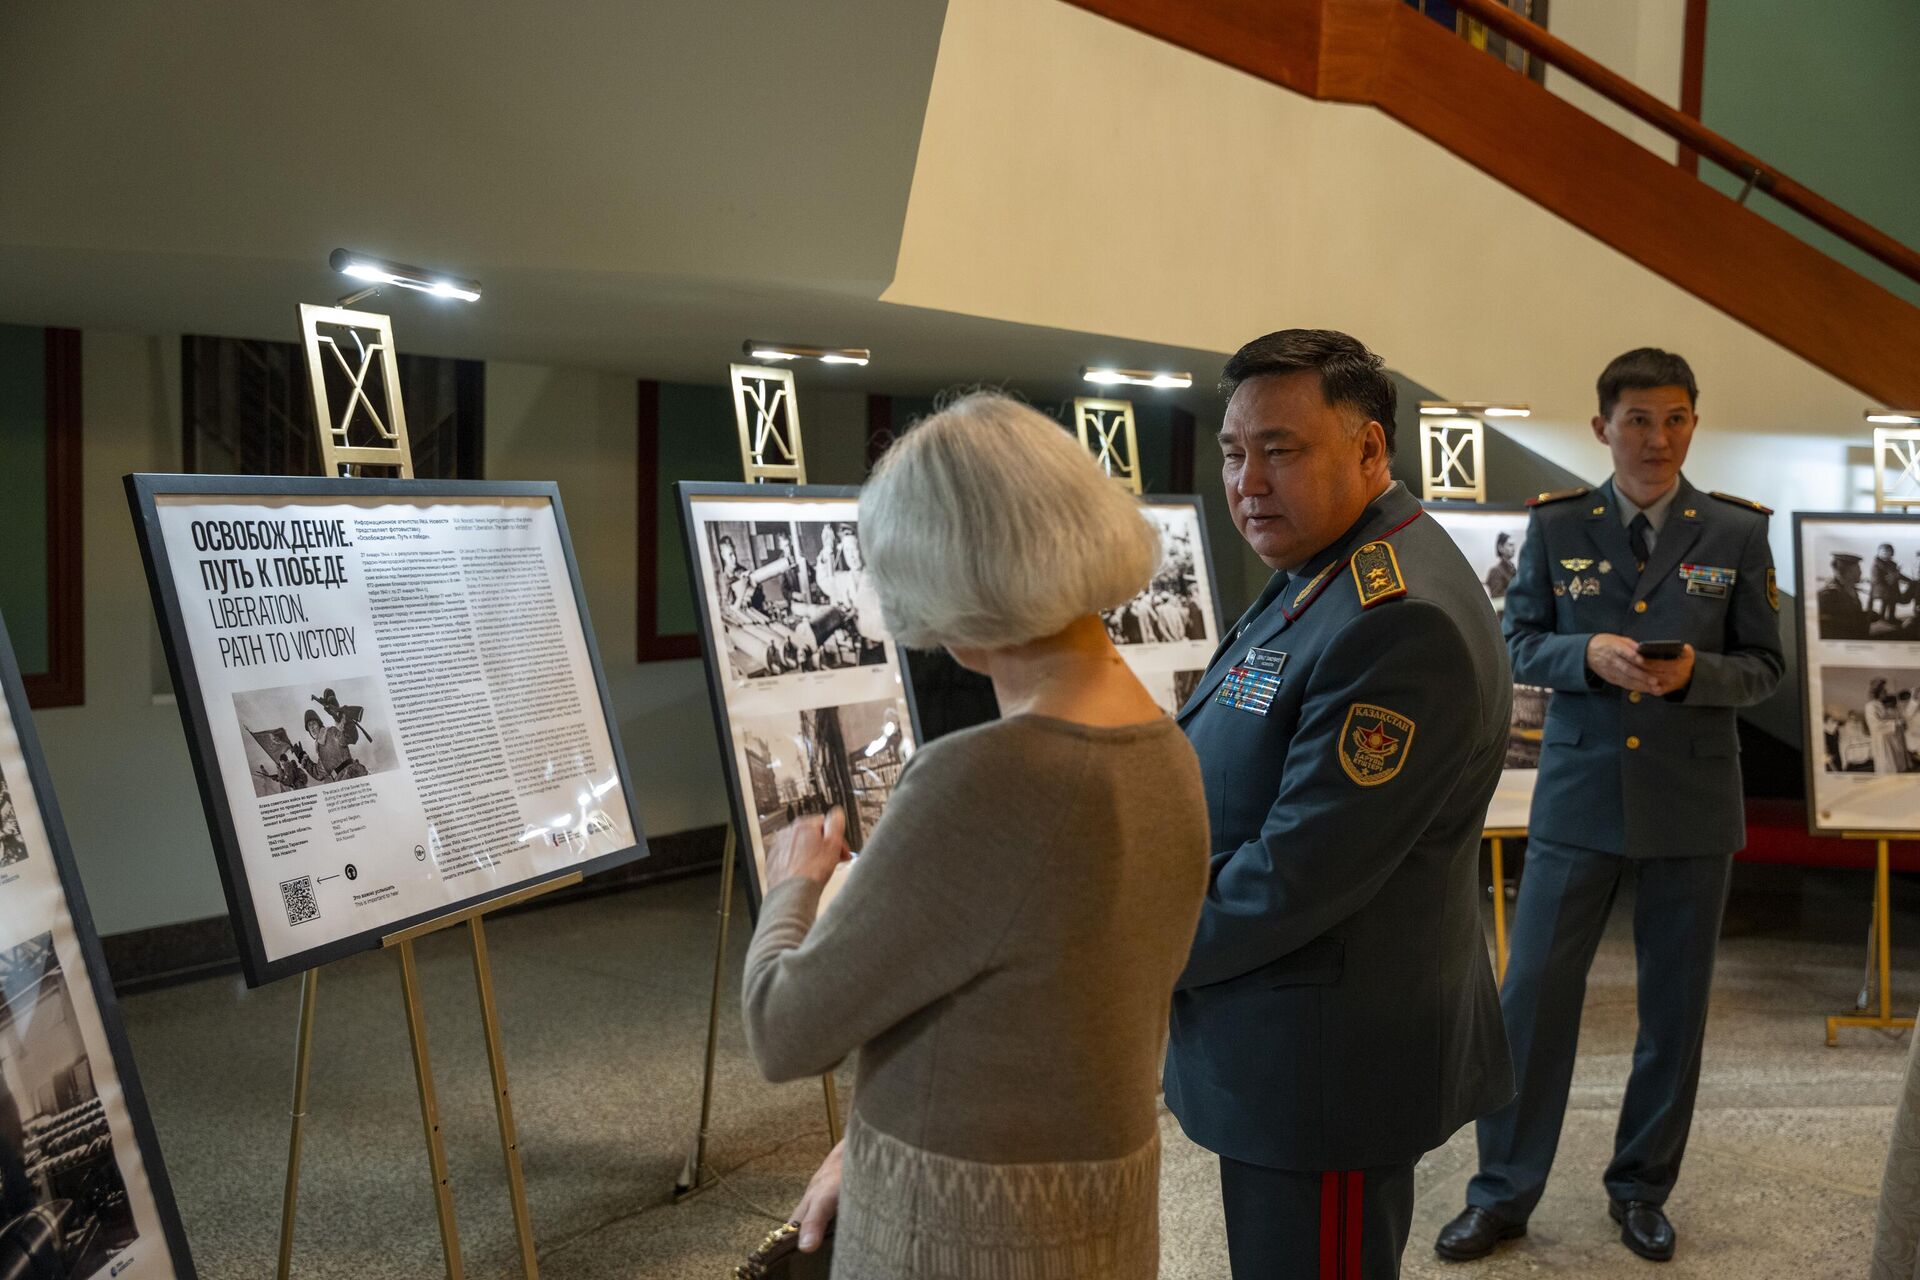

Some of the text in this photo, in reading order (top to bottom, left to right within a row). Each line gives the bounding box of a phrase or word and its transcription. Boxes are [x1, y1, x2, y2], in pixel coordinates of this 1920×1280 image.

[190, 519, 354, 554] ОСВОБОЖДЕНИЕ.
[198, 554, 349, 595] ПУТЬ К ПОБЕДЕ
[208, 593, 309, 630] LIBERATION.
[217, 625, 357, 669] PATH TO VICTORY
